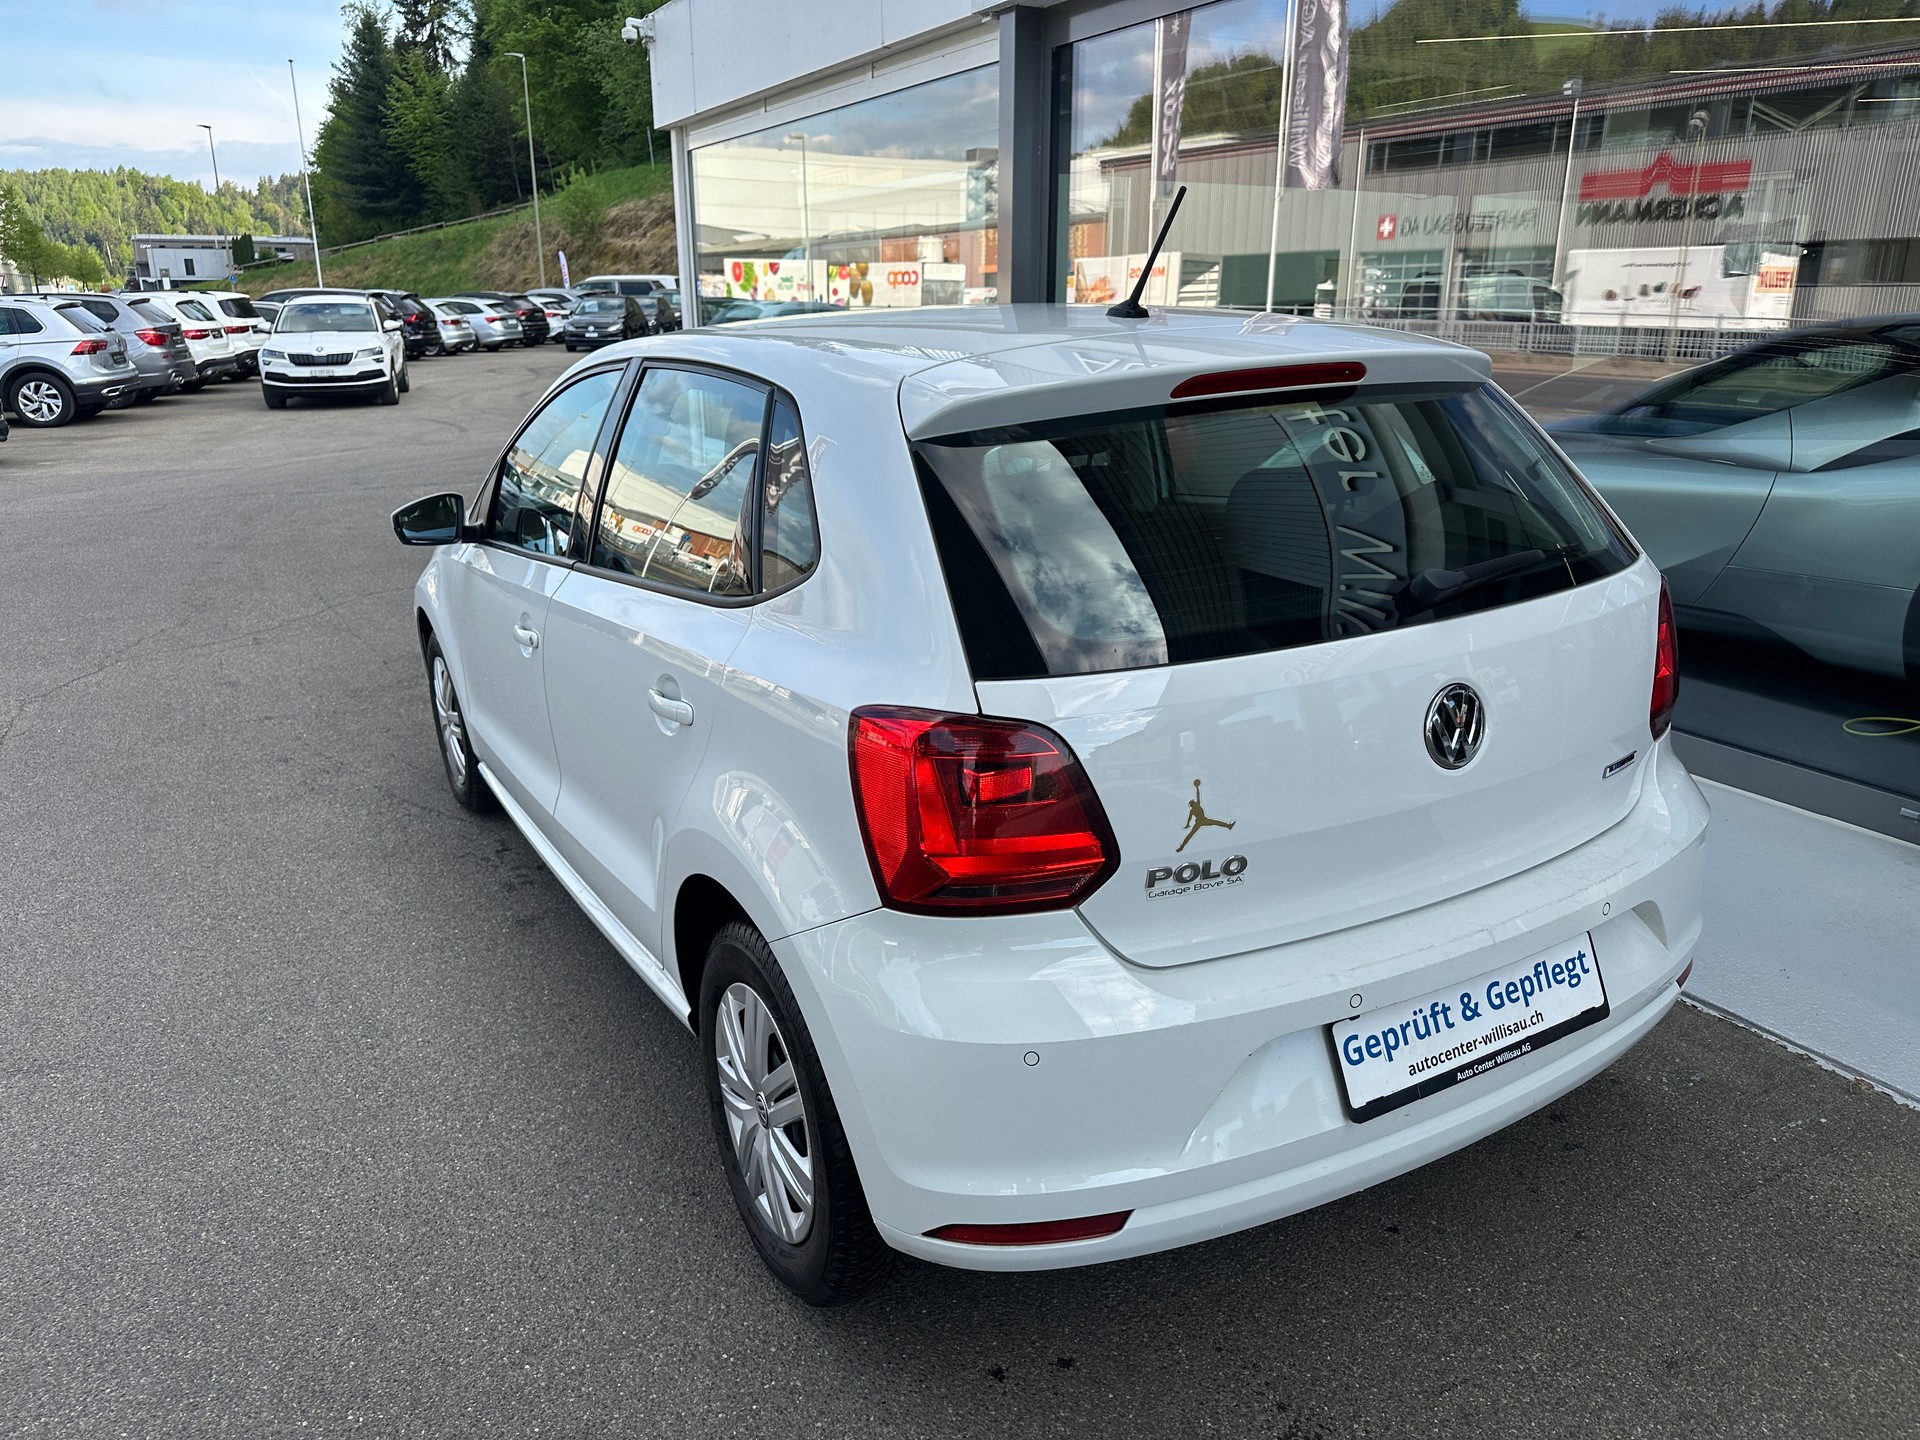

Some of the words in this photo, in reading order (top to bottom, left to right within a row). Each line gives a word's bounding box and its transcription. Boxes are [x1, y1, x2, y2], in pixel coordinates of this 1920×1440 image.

[1145, 854, 1248, 889] POLO
[1149, 886, 1191, 899] Garage
[1193, 880, 1224, 890] Bove
[1227, 875, 1243, 885] SA
[1343, 1001, 1454, 1066] Geprüft
[1460, 992, 1482, 1021] &
[1486, 950, 1590, 1010] Gepflegt
[1408, 1010, 1544, 1076] autocenter-willisau.ch
[1457, 1067, 1474, 1081] Auto
[1474, 1058, 1496, 1075] Center
[1496, 1047, 1521, 1065] Willisau
[1521, 1042, 1531, 1053] AG
